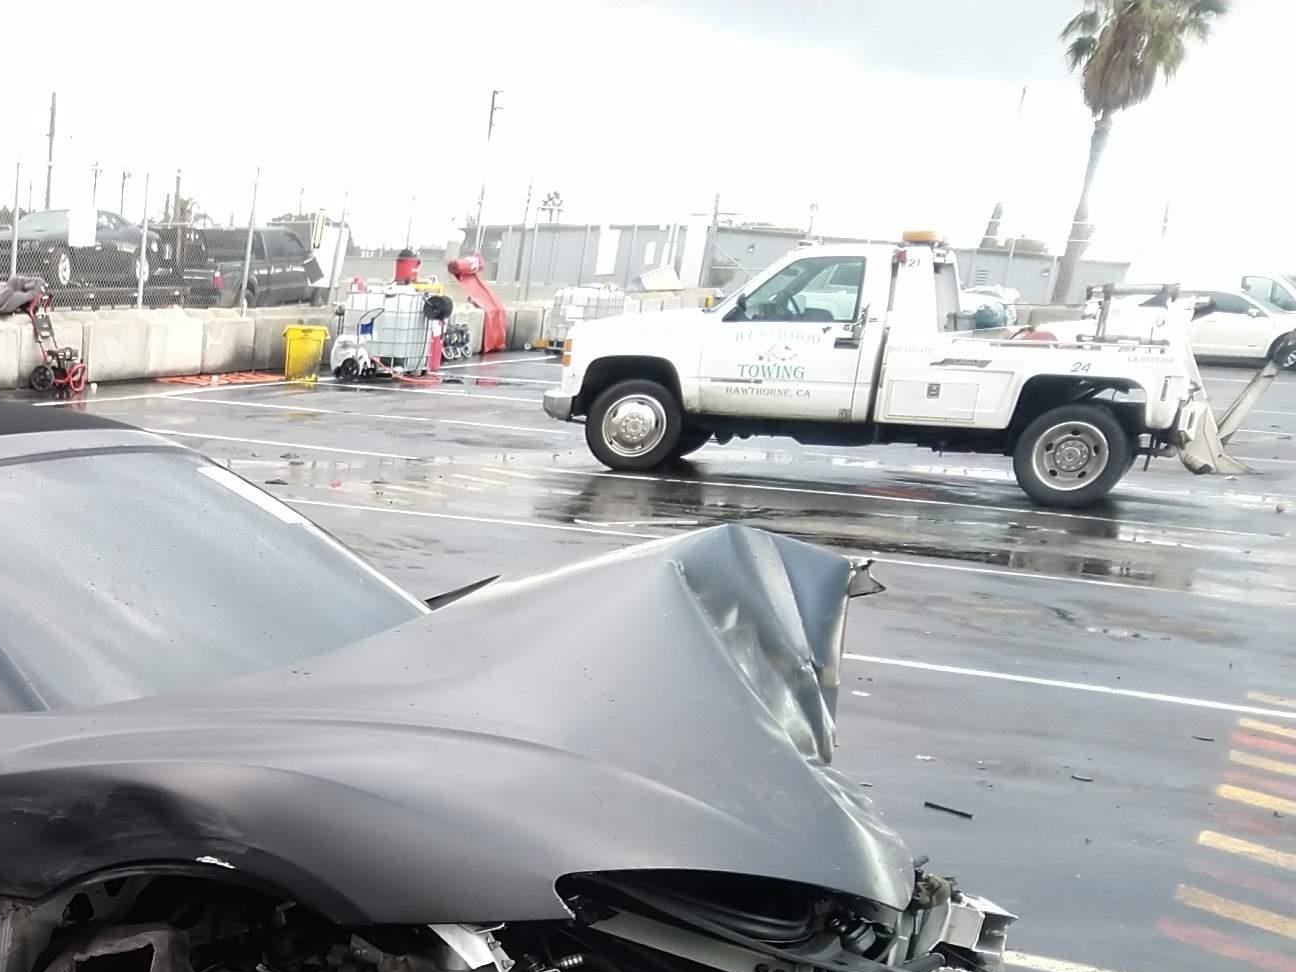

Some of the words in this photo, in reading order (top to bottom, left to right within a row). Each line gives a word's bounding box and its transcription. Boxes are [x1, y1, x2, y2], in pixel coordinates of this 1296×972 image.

[737, 363, 806, 380] TOWING
[1070, 361, 1092, 374] 24
[795, 387, 811, 398] CA
